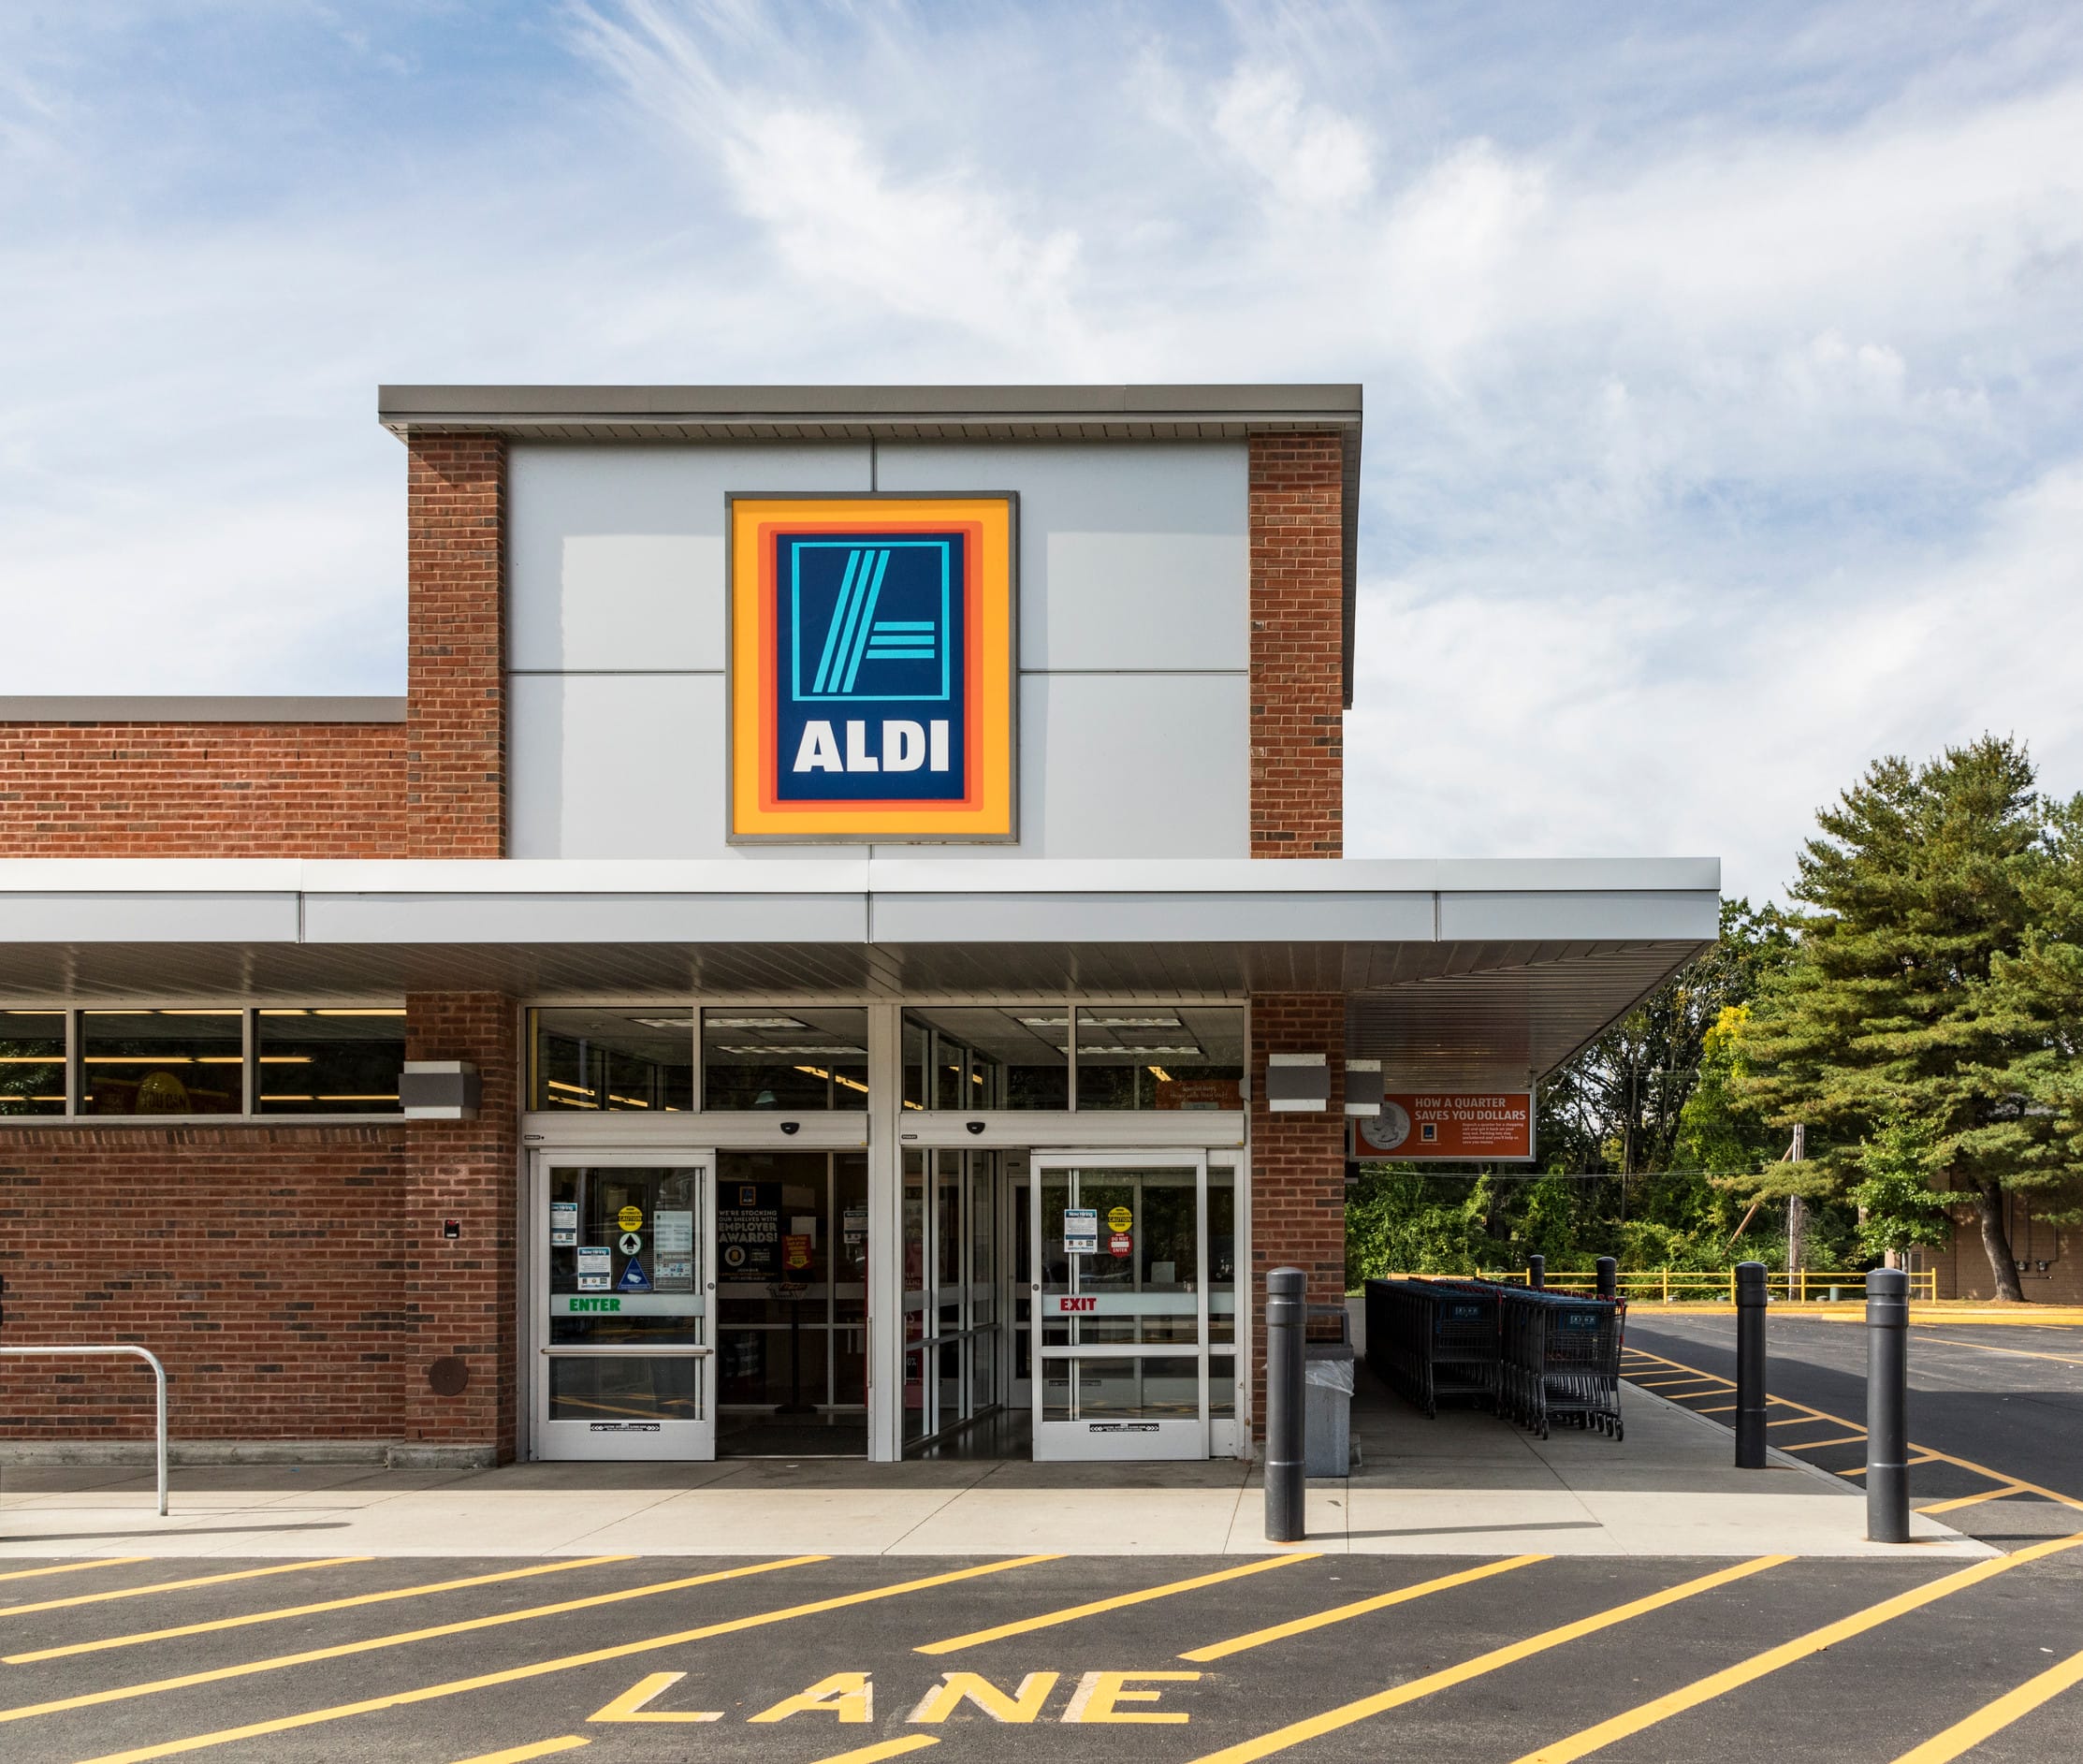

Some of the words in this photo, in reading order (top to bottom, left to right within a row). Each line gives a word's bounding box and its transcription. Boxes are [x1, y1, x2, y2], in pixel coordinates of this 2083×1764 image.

[793, 720, 950, 772] ALDI
[1415, 1098, 1441, 1108] HOW
[1444, 1098, 1452, 1108] A
[1455, 1098, 1506, 1109] QUARTER
[1414, 1110, 1449, 1120] SAVES
[1451, 1110, 1475, 1120] YOU
[1477, 1110, 1526, 1120] DOLLARS
[719, 1222, 778, 1232] EMPLOYER
[719, 1232, 778, 1243] AWARDS!
[570, 1298, 620, 1311] ENTER
[1060, 1298, 1097, 1311] EXIT
[586, 1671, 1201, 1723] LANE
